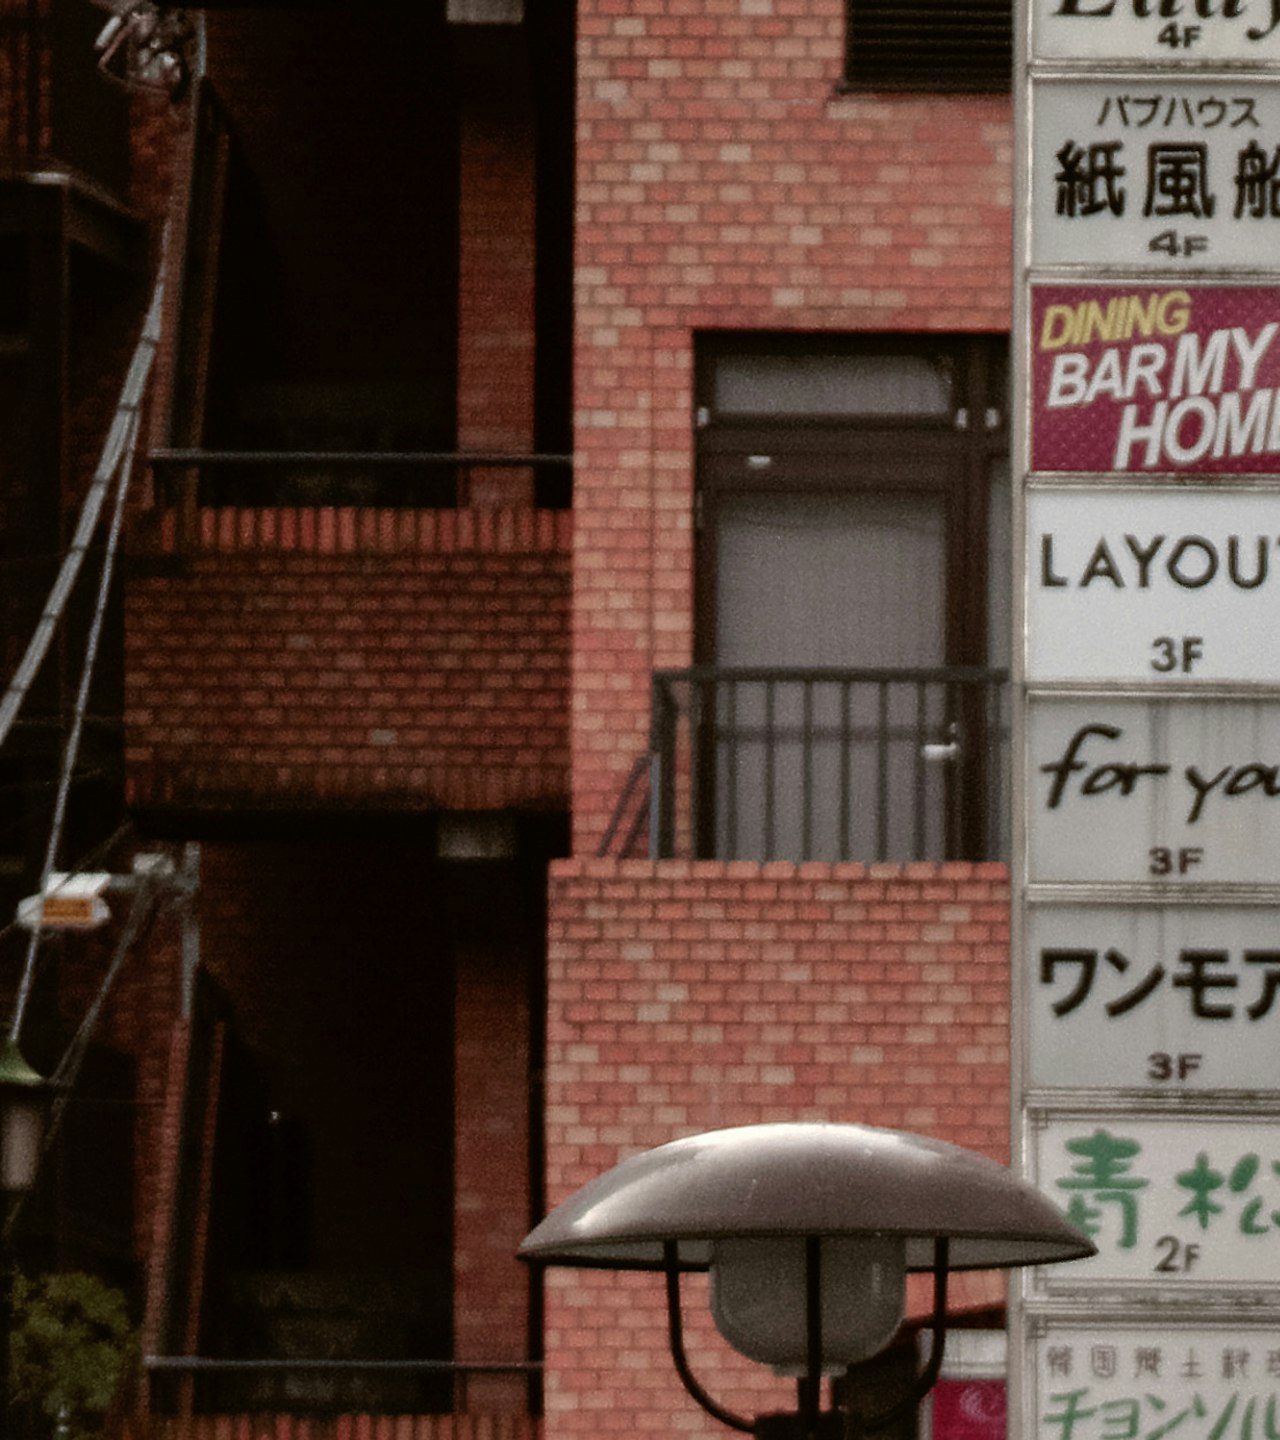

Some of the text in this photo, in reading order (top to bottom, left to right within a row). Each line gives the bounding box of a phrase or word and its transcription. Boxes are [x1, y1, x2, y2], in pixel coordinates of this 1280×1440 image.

[1157, 21, 1201, 49] 4F
[1148, 229, 1210, 258] 4F
[1039, 289, 1192, 352] DINING
[1047, 322, 1279, 410] BAR MY
[1150, 637, 1203, 674] 3F
[1040, 722, 1171, 811] for
[1147, 845, 1205, 877] 3F
[1146, 1050, 1203, 1082] 3F
[1152, 1235, 1201, 1273] 2F
